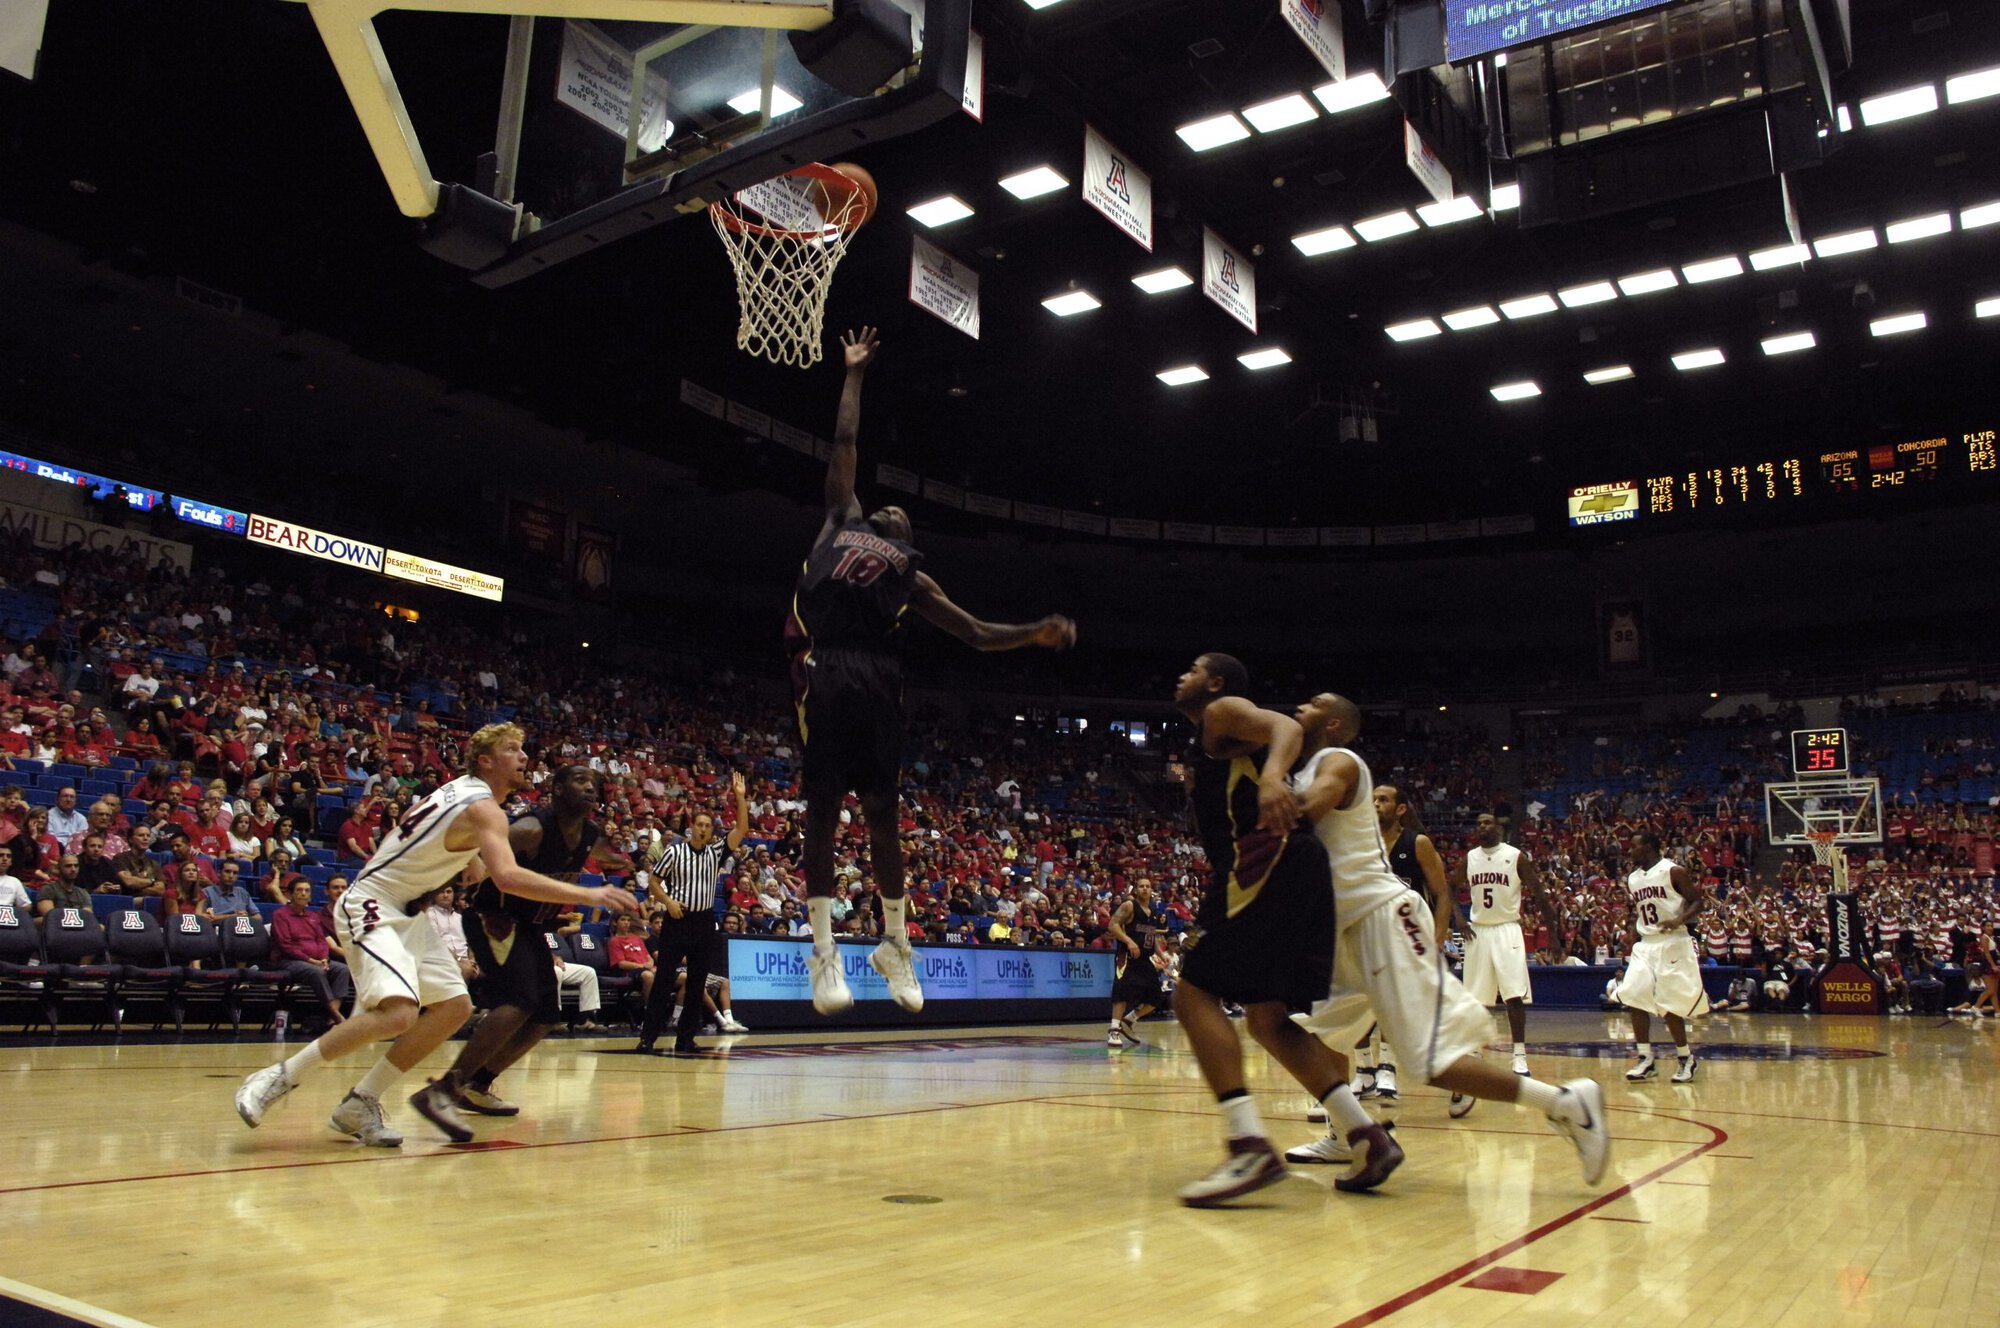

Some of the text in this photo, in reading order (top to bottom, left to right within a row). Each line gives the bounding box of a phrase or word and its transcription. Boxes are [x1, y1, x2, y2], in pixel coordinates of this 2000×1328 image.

[1502, 16, 1528, 40] of
[577, 72, 598, 89] NCAA
[567, 85, 587, 101] 2005
[1103, 202, 1122, 222] SWEET
[1123, 216, 1147, 241] SIXTEEN
[1897, 437, 1947, 453] CONCORDIA
[1963, 430, 1996, 444] PLYR
[1970, 440, 1992, 452] PTS
[1820, 450, 1858, 463] ARIZONA
[1916, 450, 1936, 466] 50
[1969, 450, 1995, 462] RBS
[1647, 459, 1800, 488] PLYR 5 13 34 42 43
[1833, 463, 1852, 477] 65
[1970, 459, 1997, 472] FLS
[1652, 485, 1671, 495] PTS
[1785, 468, 1800, 478] 12
[1871, 471, 1905, 488] 2:42
[1573, 481, 1631, 497] O'RIELLY
[1651, 494, 1673, 504] RBS
[1741, 484, 1749, 493] 3
[1793, 477, 1801, 487] 4
[1652, 502, 1673, 513] FLS
[1793, 486, 1802, 495] 3
[146, 493, 155, 508] 1
[179, 502, 223, 526] Fouls
[224, 513, 236, 528] 3
[1575, 510, 1634, 526] WATSON
[386, 557, 413, 570] DESERT
[415, 564, 442, 577] TOYOTA
[449, 573, 474, 585] DESERT
[477, 580, 502, 592] TOYOTA
[1614, 629, 1635, 643] 32
[1807, 732, 1840, 747] 2:42
[1807, 748, 1835, 769] 35
[1471, 872, 1510, 886] ARIZONA
[1483, 888, 1494, 909] 5
[1640, 902, 1659, 926] 13
[1397, 902, 1426, 956] CATS
[1836, 899, 1851, 958] ARIZONA
[755, 952, 789, 975] UPH
[844, 955, 875, 977] UPH
[926, 957, 953, 978] UPH
[997, 959, 1020, 978] UPH
[1060, 961, 1080, 979] UPH
[1823, 982, 1872, 991] WELLS
[1825, 993, 1872, 1003] FARGO
